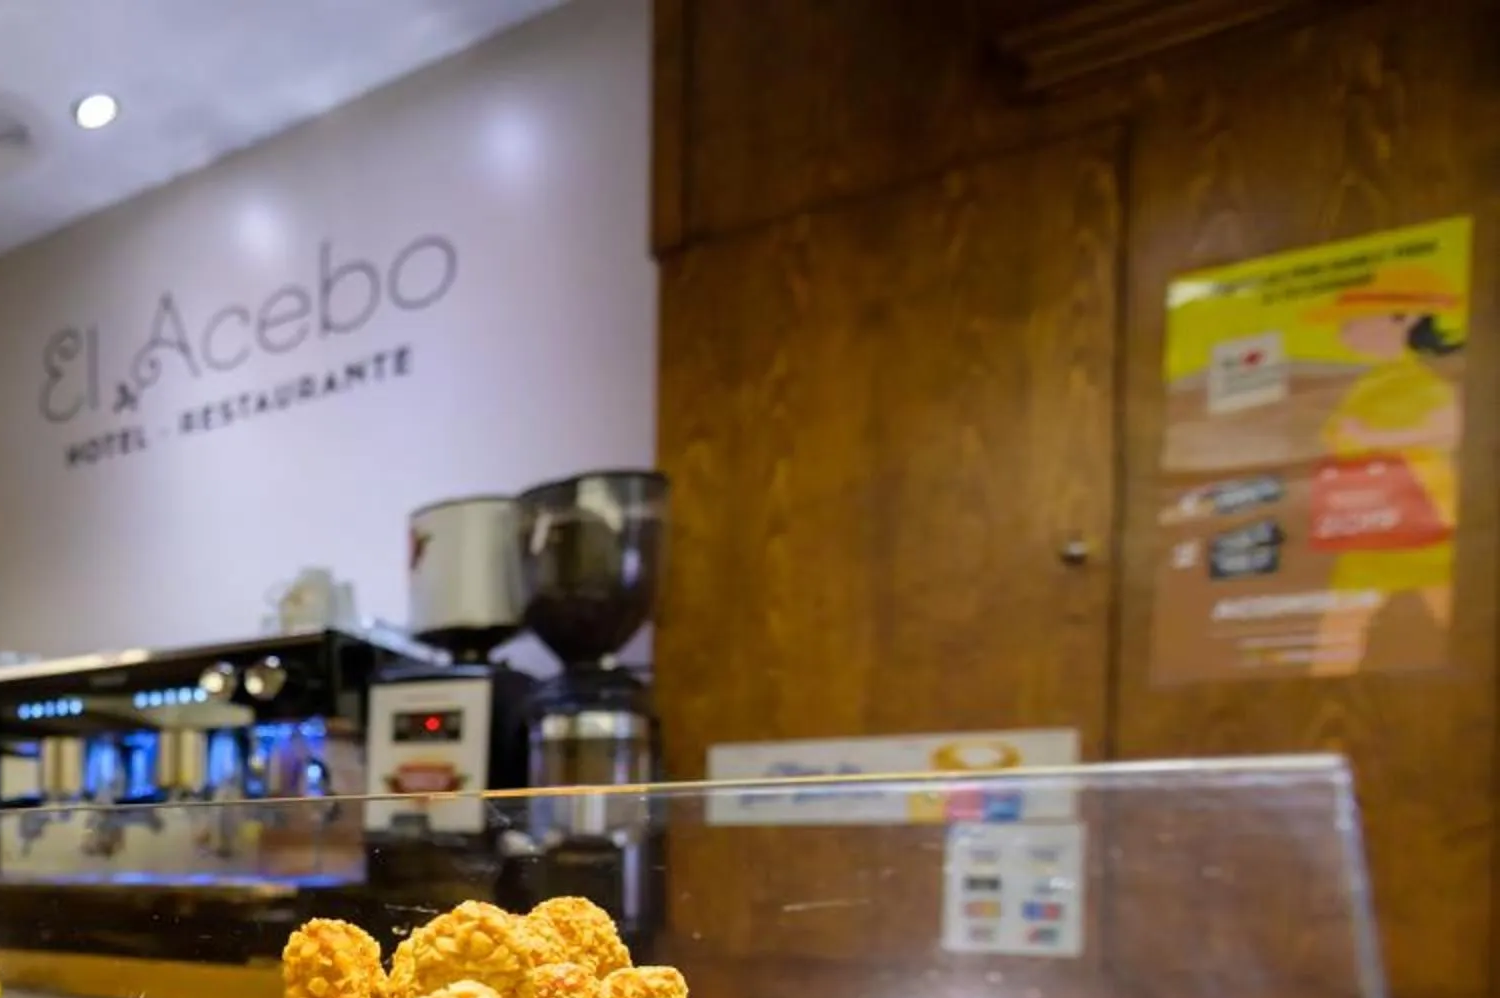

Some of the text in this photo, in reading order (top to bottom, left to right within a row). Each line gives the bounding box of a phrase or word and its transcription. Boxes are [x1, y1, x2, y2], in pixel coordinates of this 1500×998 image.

[38, 234, 458, 424] El Acebo
[65, 343, 412, 468] HOTEL RESTAURANTE
